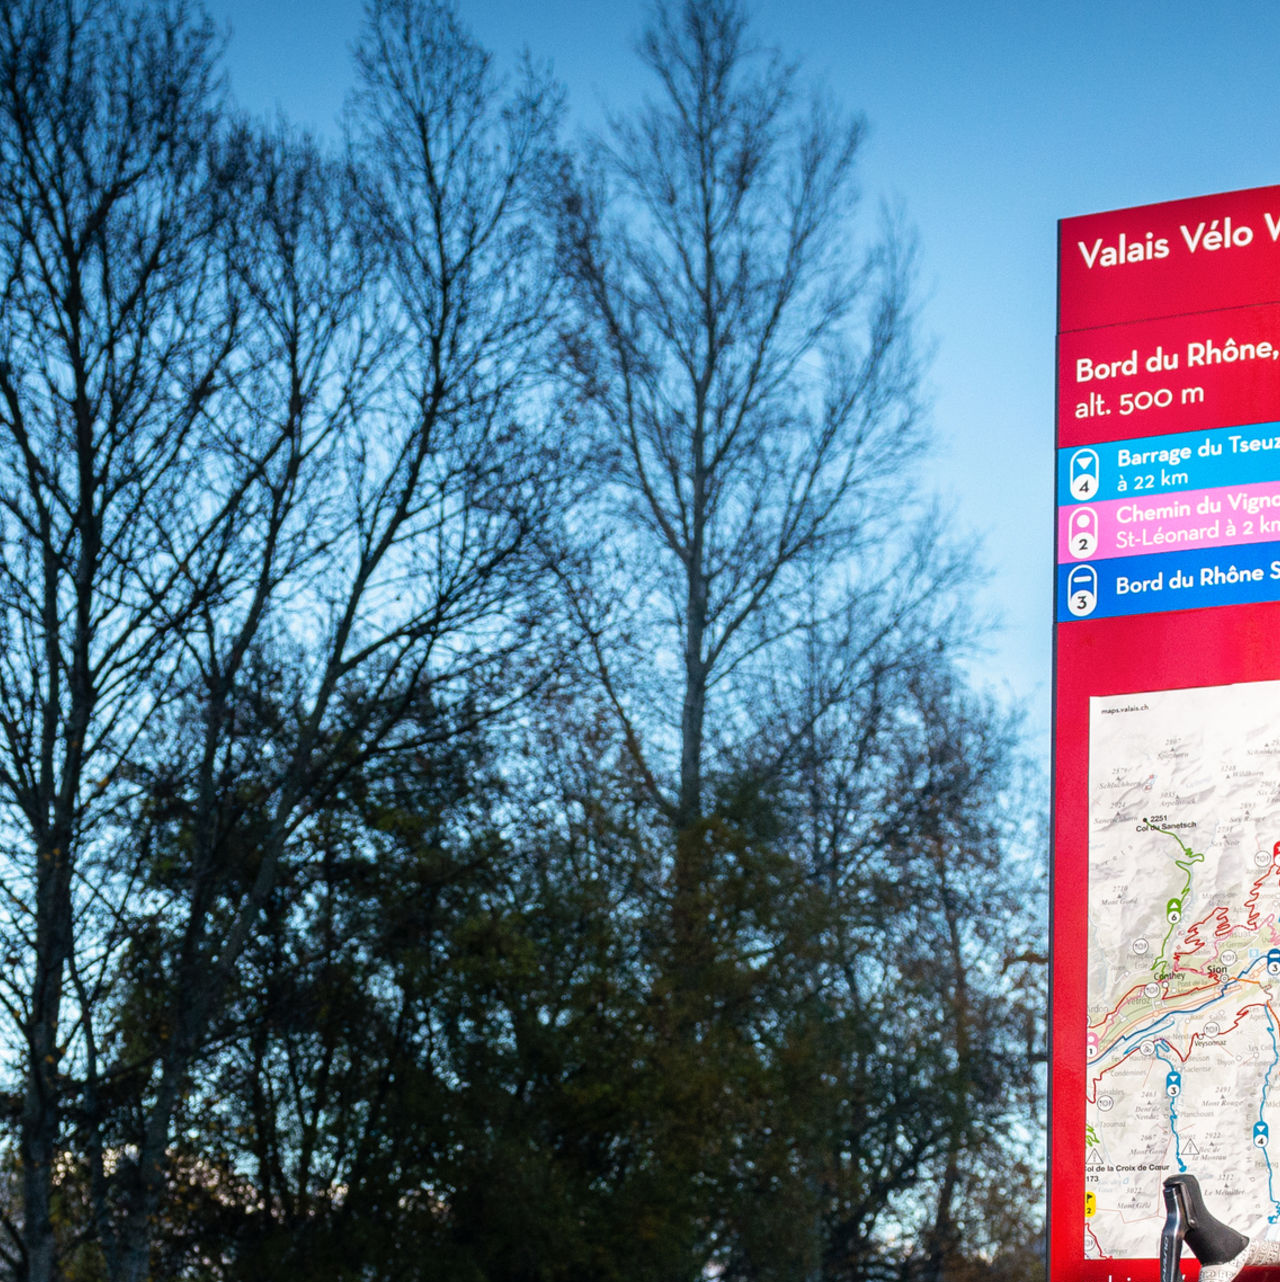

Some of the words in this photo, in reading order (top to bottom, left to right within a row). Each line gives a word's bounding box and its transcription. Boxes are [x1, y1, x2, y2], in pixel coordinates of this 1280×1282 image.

[1078, 232, 1170, 270] Valais
[1180, 217, 1254, 254] Vélo
[1076, 349, 1138, 383] Bord
[1145, 346, 1179, 374] du
[1187, 337, 1280, 369] Rhône,
[1075, 395, 1112, 420] alt.
[1119, 388, 1174, 417] 500
[1181, 385, 1205, 404] m
[1117, 443, 1192, 468] Barrage
[1197, 439, 1223, 458] du
[1078, 479, 1090, 494] 4
[1117, 476, 1128, 492] à
[1133, 475, 1155, 490] 22
[1161, 470, 1189, 488] km
[1116, 502, 1192, 526] Chemin
[1196, 498, 1222, 518] du
[1116, 520, 1220, 550] St-Léonard
[1225, 521, 1237, 536] à
[1243, 521, 1254, 535] 2
[1078, 538, 1089, 551] 2
[1116, 576, 1164, 596] Bord
[1169, 572, 1195, 591] du
[1200, 564, 1264, 587] Rhône
[1076, 596, 1088, 610] 3
[1136, 824, 1149, 833] Col
[1161, 821, 1197, 830] Sanetsch
[1150, 814, 1168, 823] 2251
[1207, 965, 1227, 975] Sion
[1272, 964, 1278, 972] 3
[1171, 1086, 1177, 1094] 3
